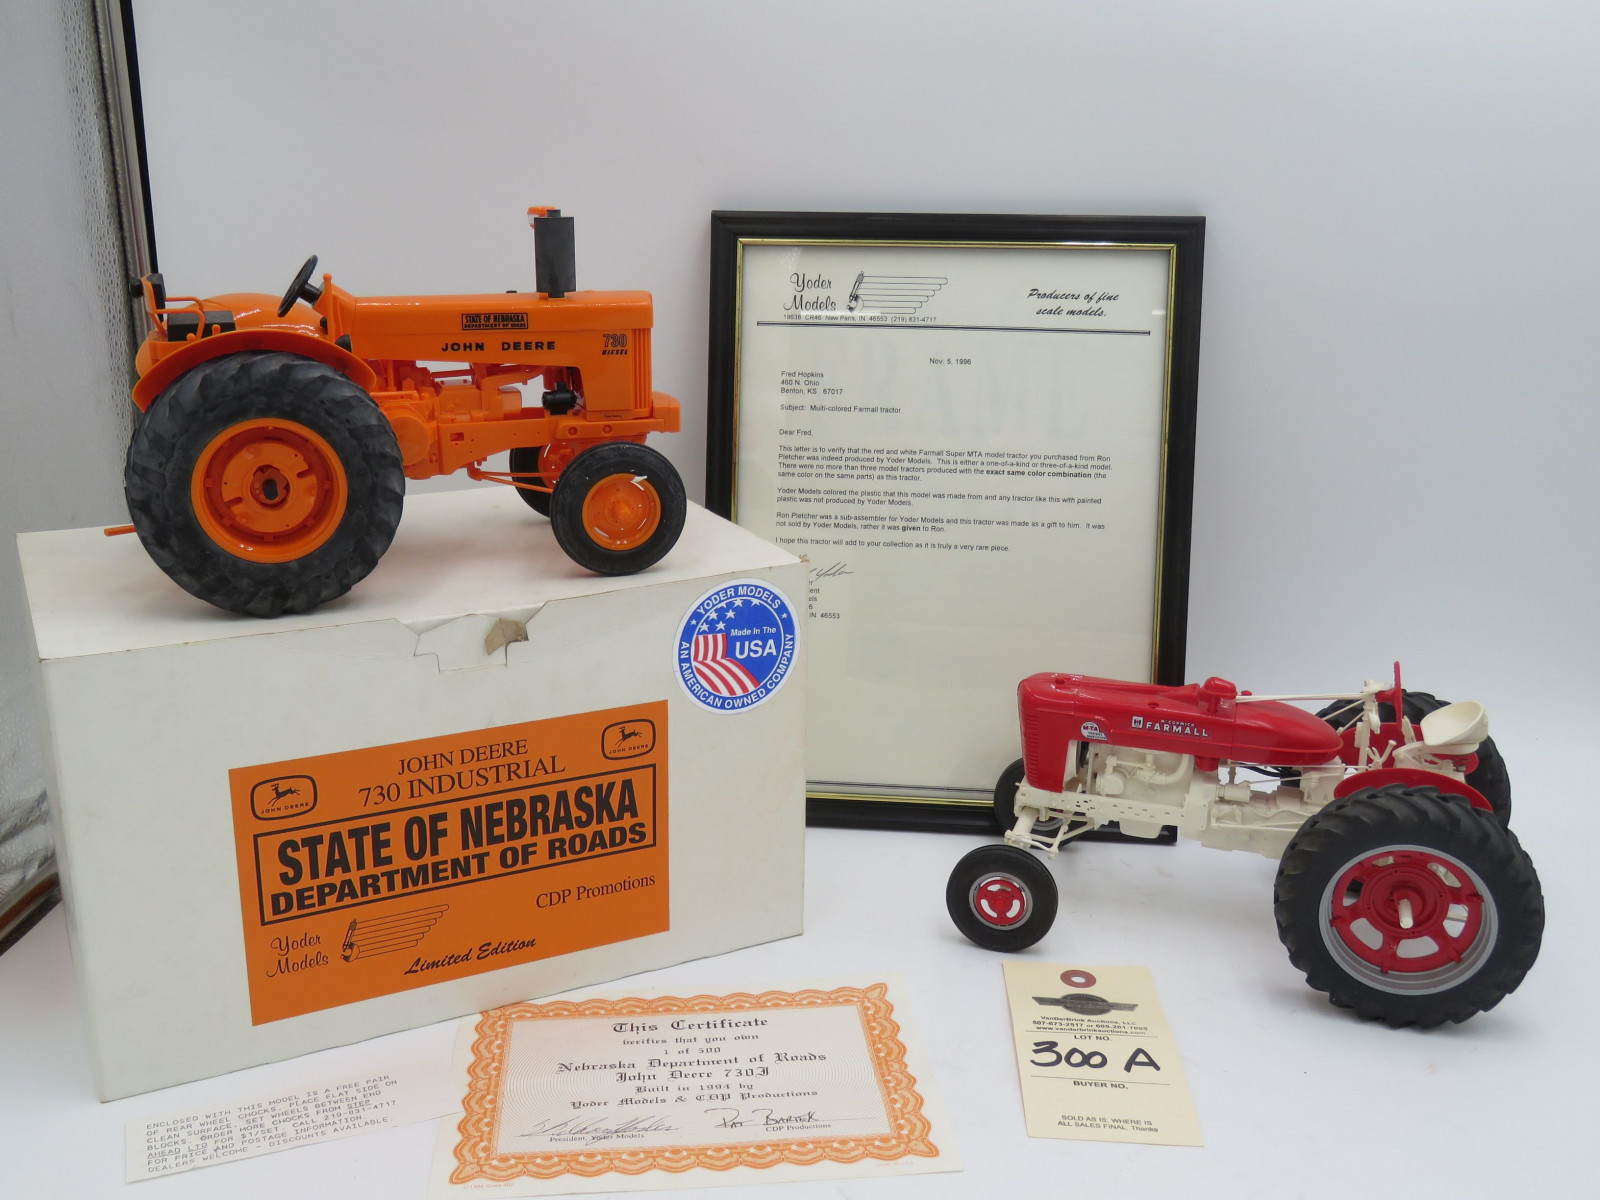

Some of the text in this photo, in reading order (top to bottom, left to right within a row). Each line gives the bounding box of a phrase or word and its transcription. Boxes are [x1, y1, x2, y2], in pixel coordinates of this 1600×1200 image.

[790, 273, 832, 292] Yoder
[783, 295, 836, 311] Models
[1027, 289, 1119, 304] Producers of fine
[1036, 306, 1107, 316] scale models.
[442, 342, 555, 351] JOHN DEERE
[603, 334, 627, 347] 730
[828, 447, 846, 455] verify
[697, 586, 781, 615] YODER MODELS
[735, 639, 777, 659] USA
[680, 634, 793, 708] AN AMERICAN OWNED COMPANY
[1146, 722, 1208, 736] FARMALL
[398, 739, 528, 776] JOHN DEERE
[359, 755, 566, 807] 730 INDUSTRIAL
[285, 802, 309, 810] DEERE
[278, 778, 638, 885] STATE OF NEBRASKA
[272, 822, 647, 916] DEPARTMENT OF ROADS
[536, 874, 656, 908] CDP Promotions
[271, 932, 321, 956] Yoder
[266, 951, 328, 977] Models
[404, 936, 537, 976] Limited Edition
[611, 1018, 768, 1034] This Certificate
[556, 1052, 827, 1074] Nebraska Department of Roads
[1030, 1041, 1161, 1073] 300 A
[616, 1072, 657, 1083] John
[667, 1070, 713, 1081] Deere
[635, 1085, 670, 1094] Built
[147, 1116, 199, 1129] ENCLOSED
[205, 1110, 231, 1119] WITH
[238, 1103, 262, 1112] THIS
[269, 1095, 300, 1105] MODEL
[336, 1082, 359, 1090] FREE
[366, 1075, 390, 1084] PAIR
[570, 1100, 609, 1110] Yoder
[617, 1097, 666, 1107] Models
[695, 1093, 731, 1102] CDP
[739, 1090, 819, 1099] Productions
